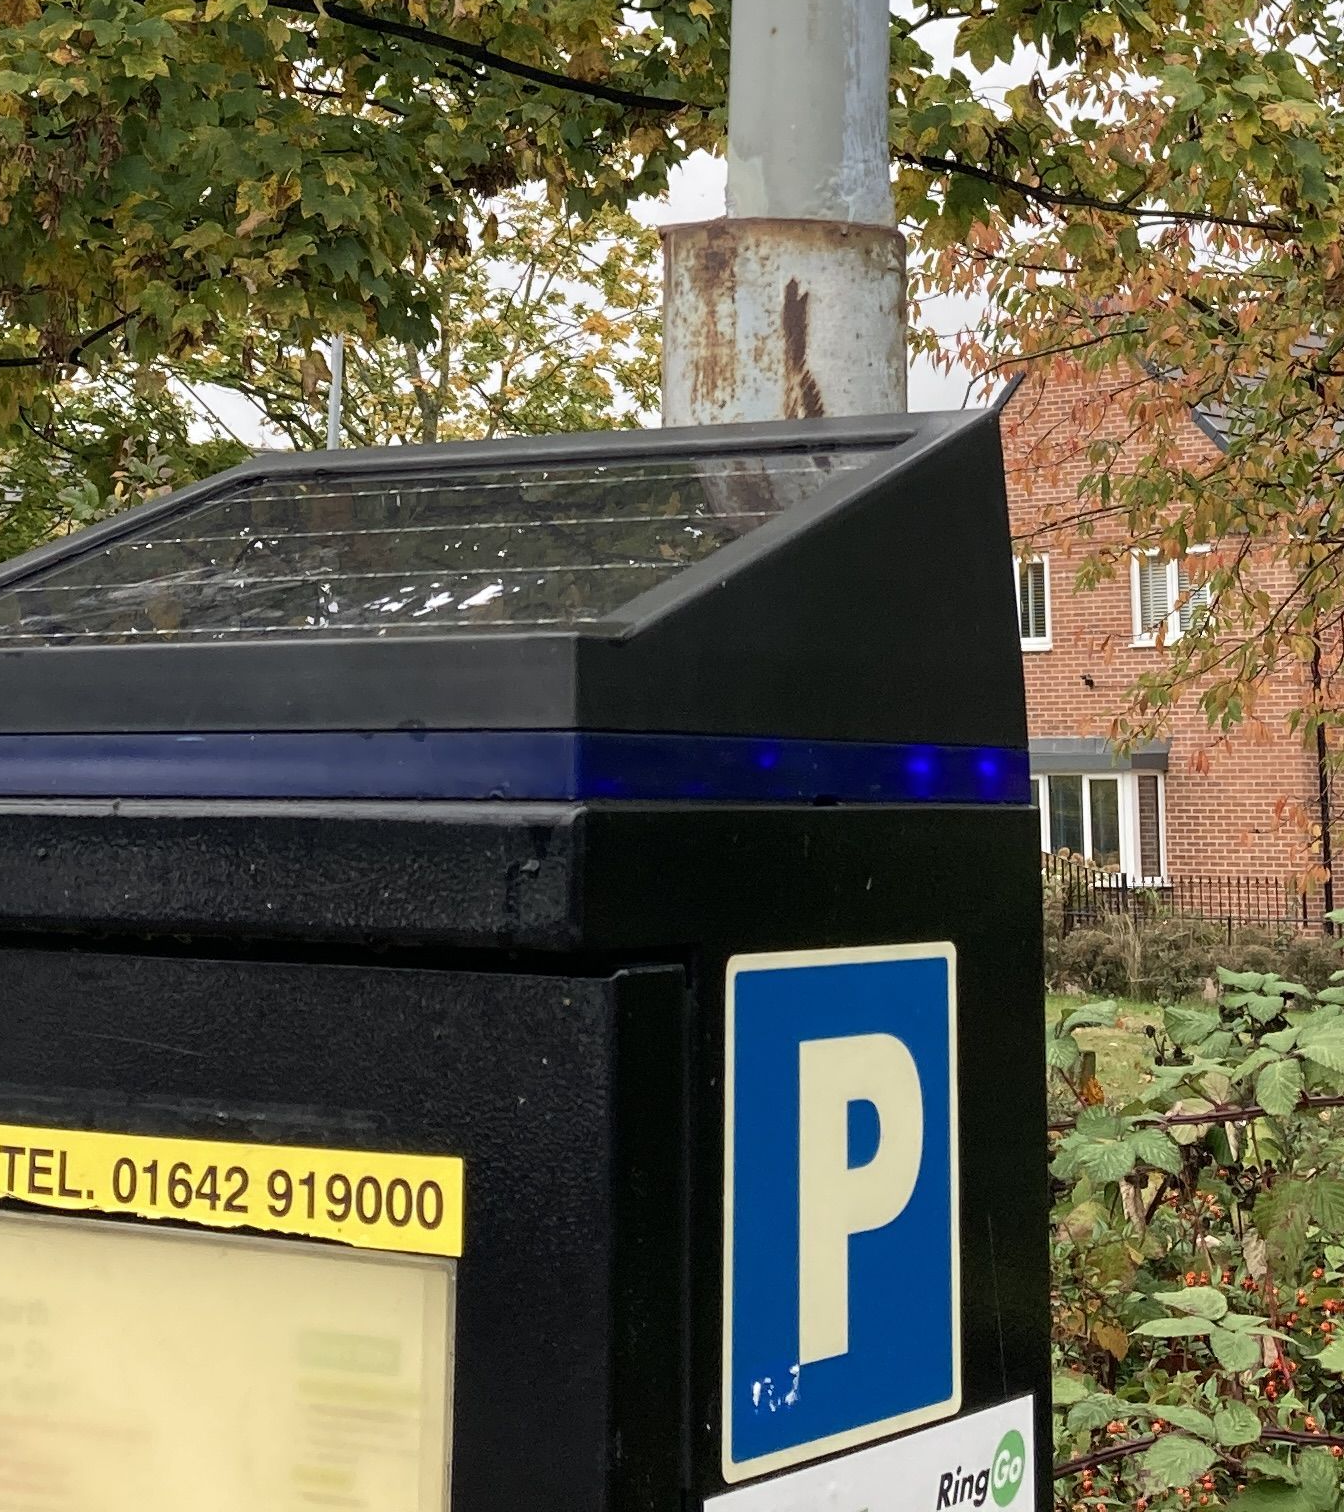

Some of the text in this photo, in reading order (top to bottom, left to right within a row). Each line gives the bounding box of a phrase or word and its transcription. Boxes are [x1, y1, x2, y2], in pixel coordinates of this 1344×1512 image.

[0, 1143, 96, 1200] TEL.
[112, 1156, 250, 1215] 01642
[267, 1169, 444, 1231] 919000
[798, 1031, 924, 1366] P
